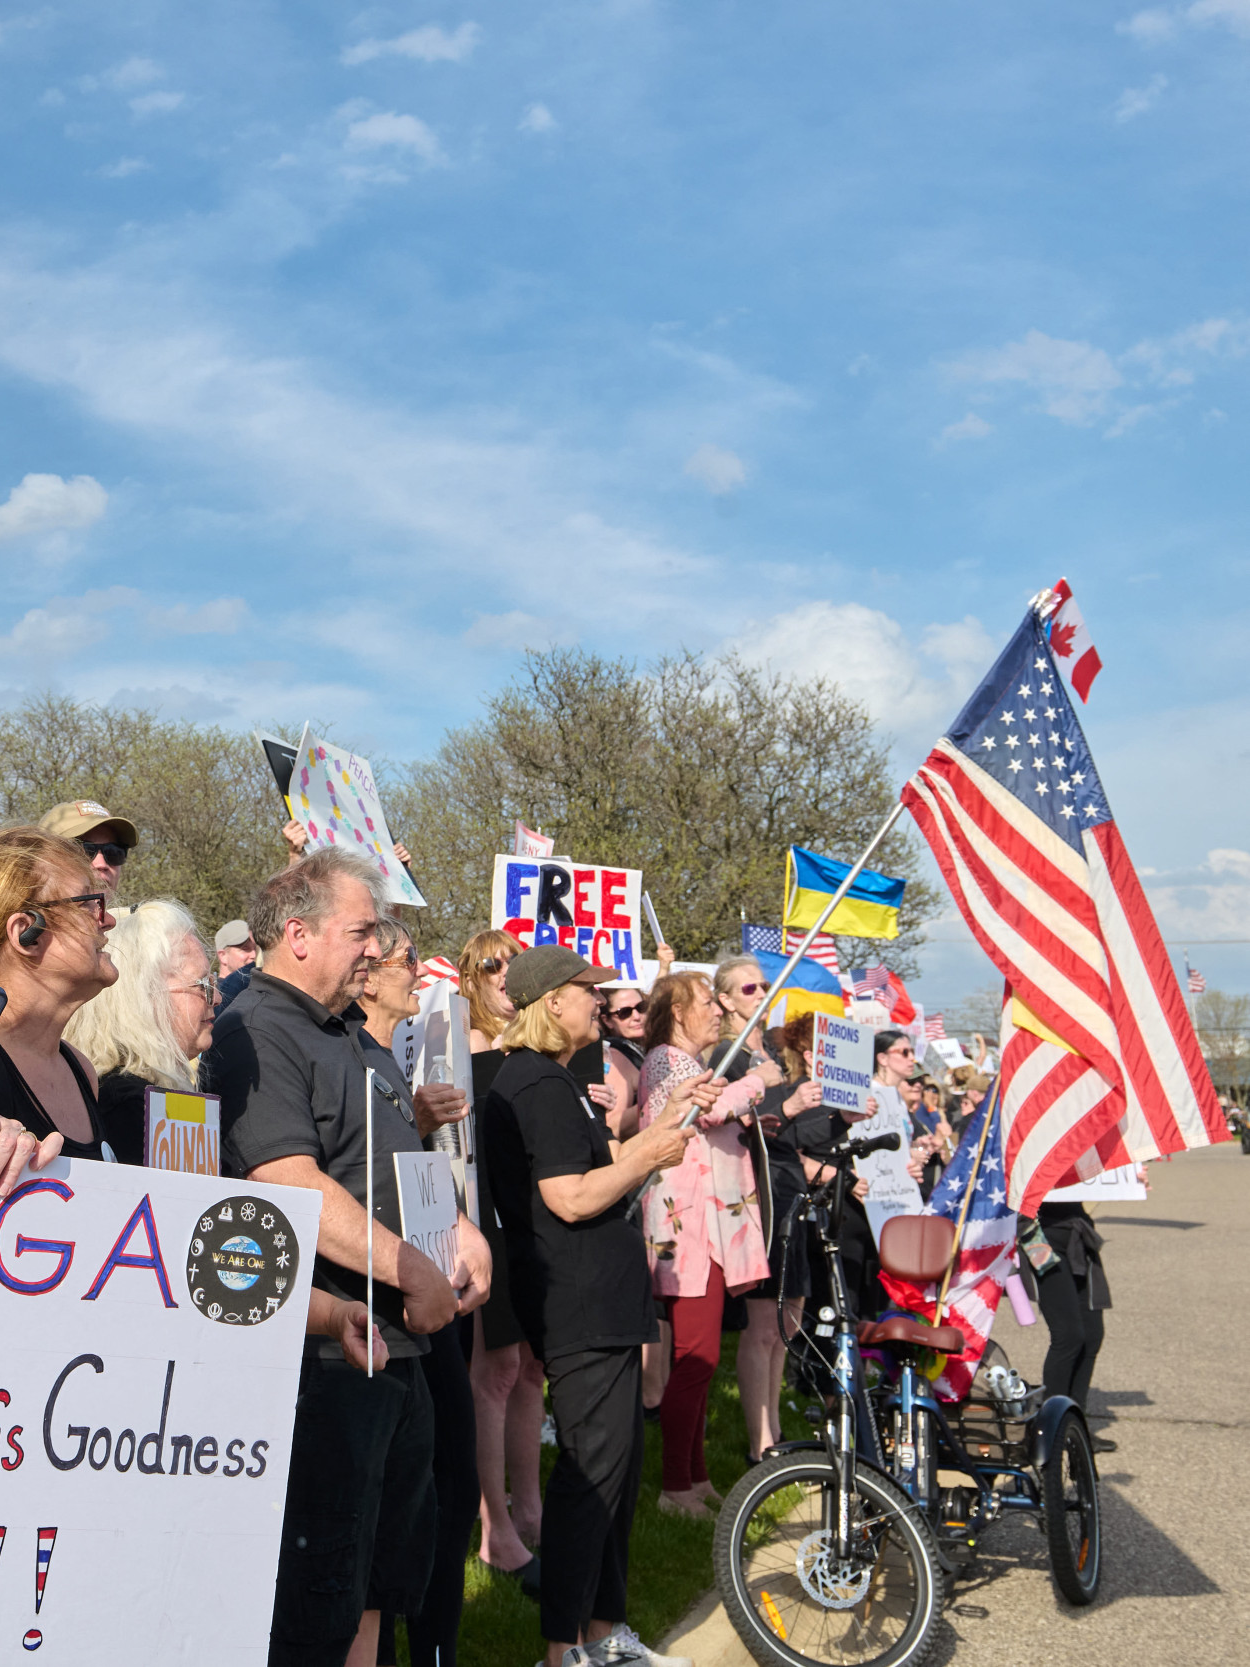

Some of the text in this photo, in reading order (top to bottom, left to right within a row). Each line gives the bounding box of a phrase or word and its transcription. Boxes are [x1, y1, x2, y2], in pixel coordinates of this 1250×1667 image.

[348, 754, 376, 802] PEACE
[505, 862, 631, 929] FREE
[817, 1016, 860, 1043] MORONS
[816, 1039, 837, 1059] ARE
[816, 1060, 871, 1088] GOVERNING
[822, 1086, 859, 1107] MERICA
[414, 1162, 437, 1208] WE
[212, 1252, 266, 1269] WE ARE ONE
[43, 1353, 270, 1480] Goodness
